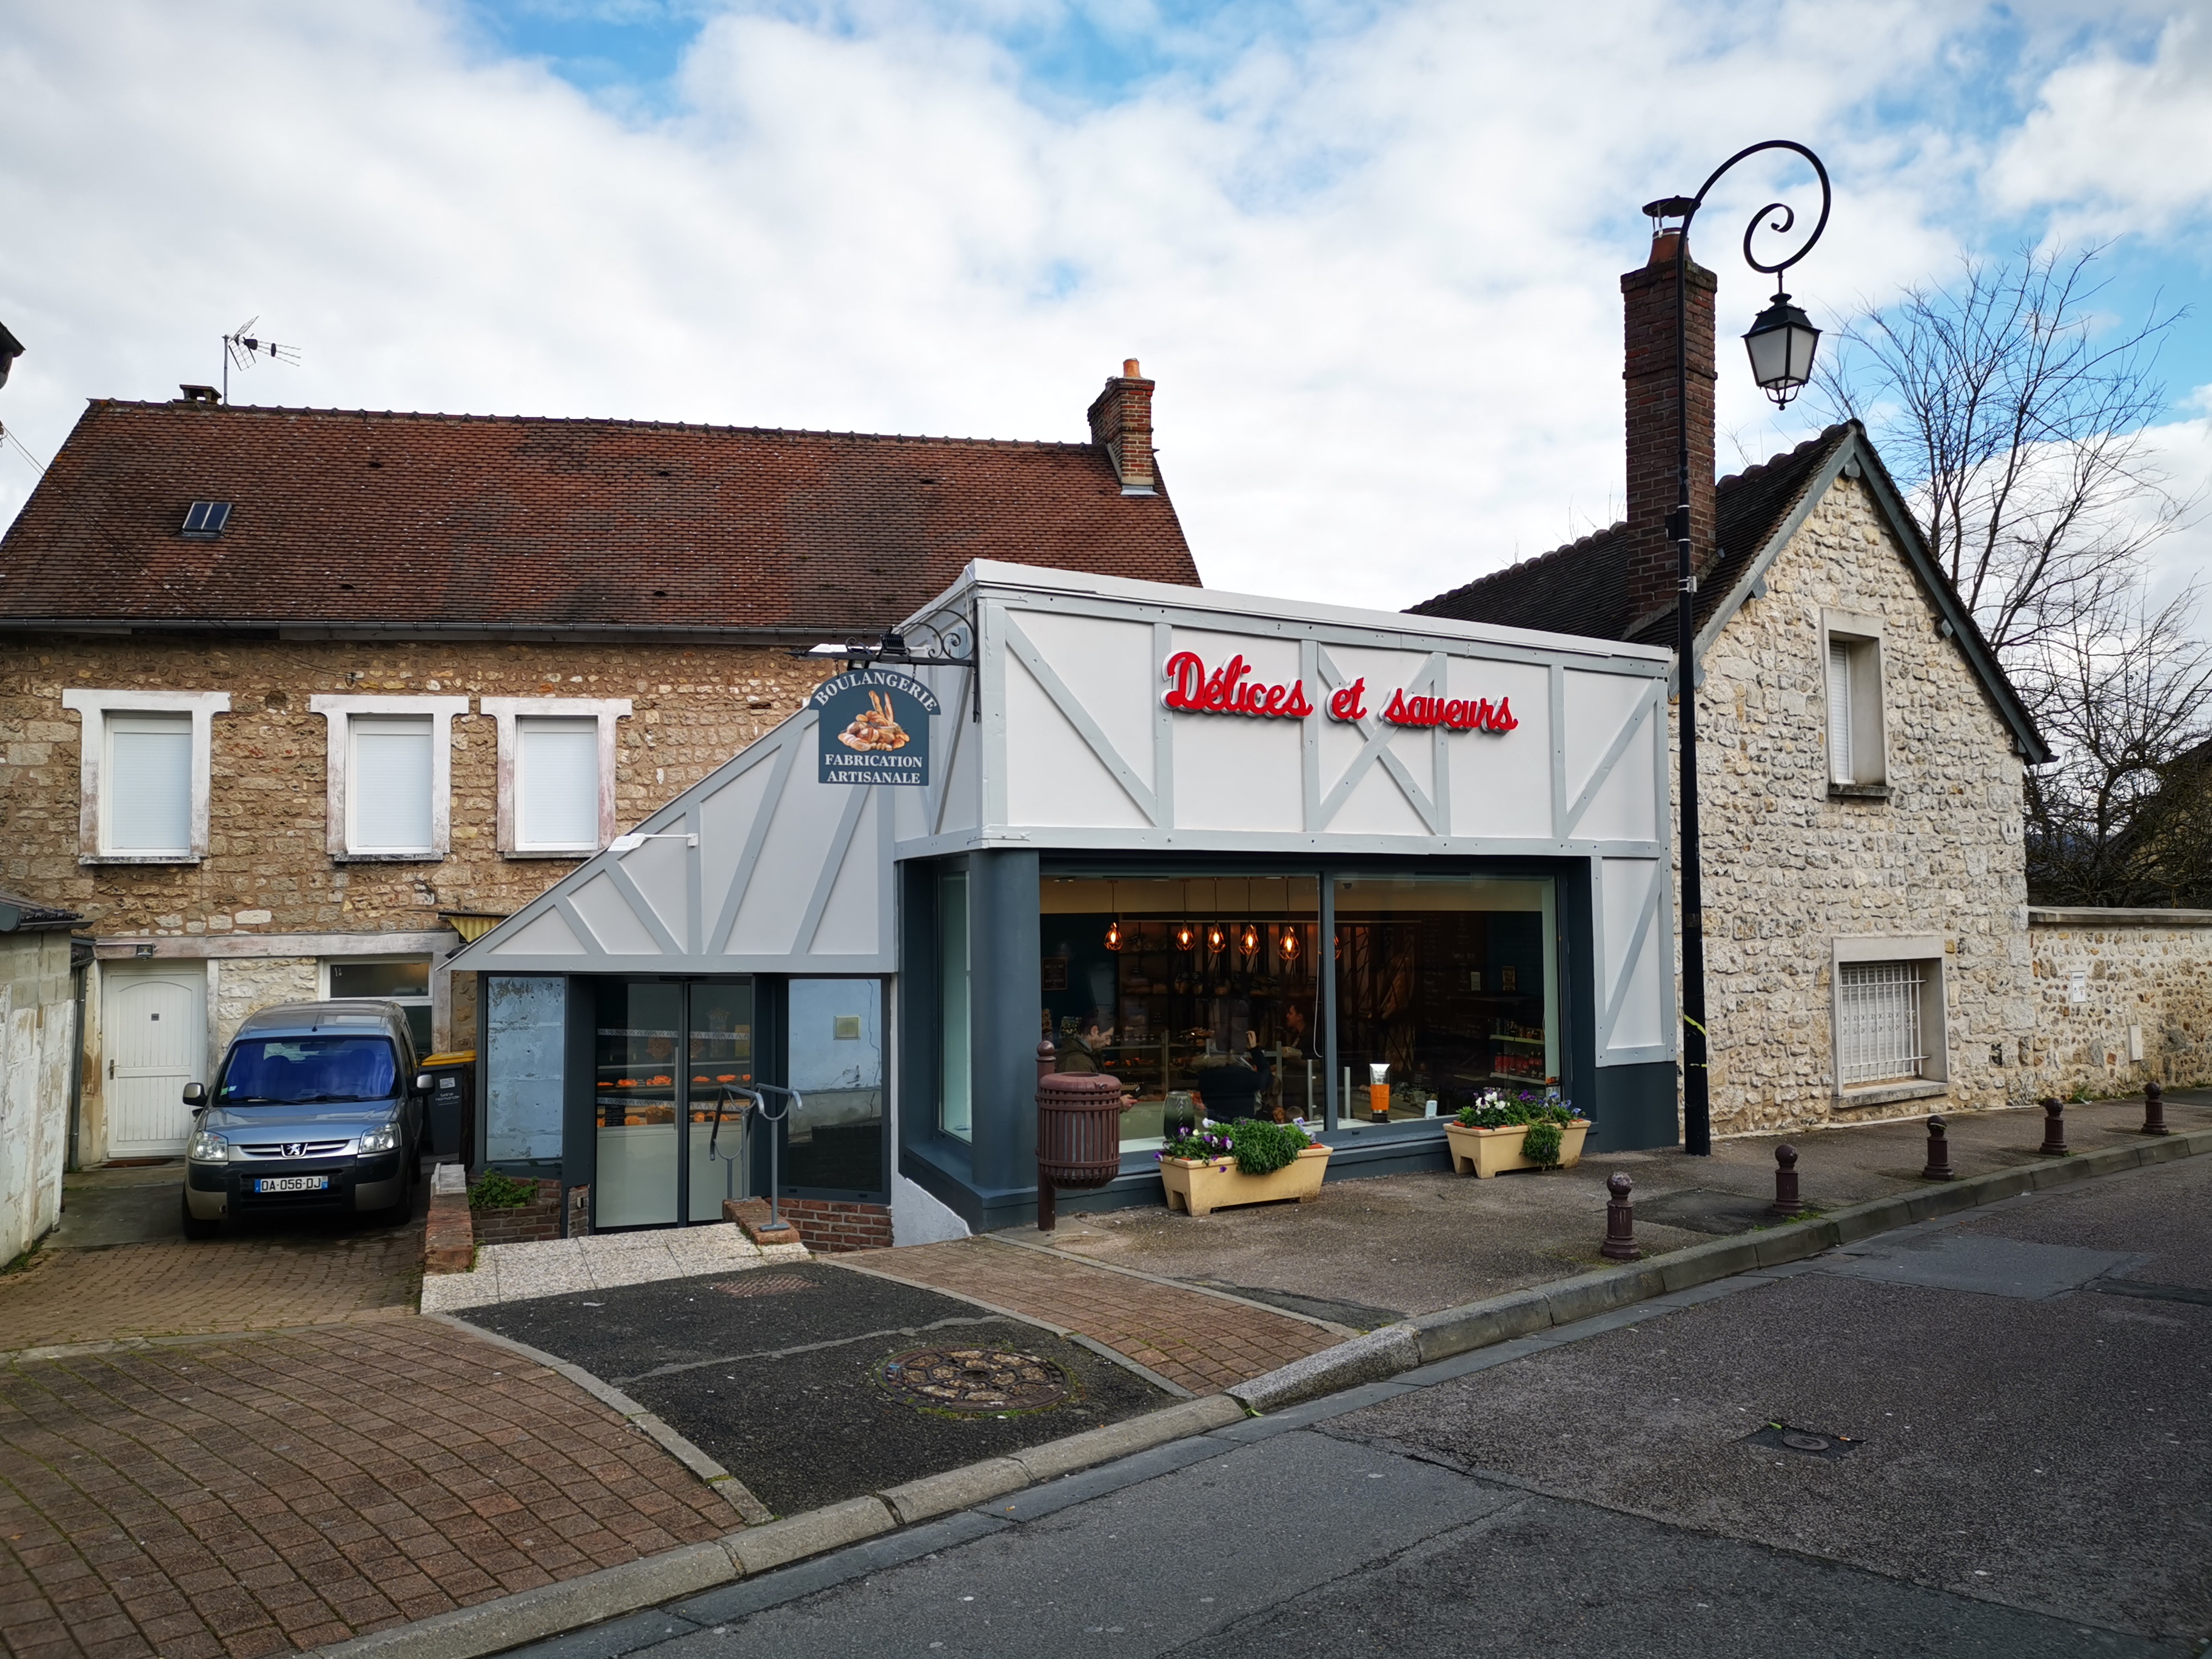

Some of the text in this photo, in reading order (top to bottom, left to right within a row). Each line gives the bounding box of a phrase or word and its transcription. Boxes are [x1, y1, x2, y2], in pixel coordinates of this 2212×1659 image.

[814, 671, 937, 711] BOULANGERIE
[1166, 652, 1518, 730] Délices et saveurs
[825, 754, 923, 768] FABRICATION
[826, 771, 920, 784] ARTISANALE
[261, 1178, 321, 1191] DA-056-DJ
